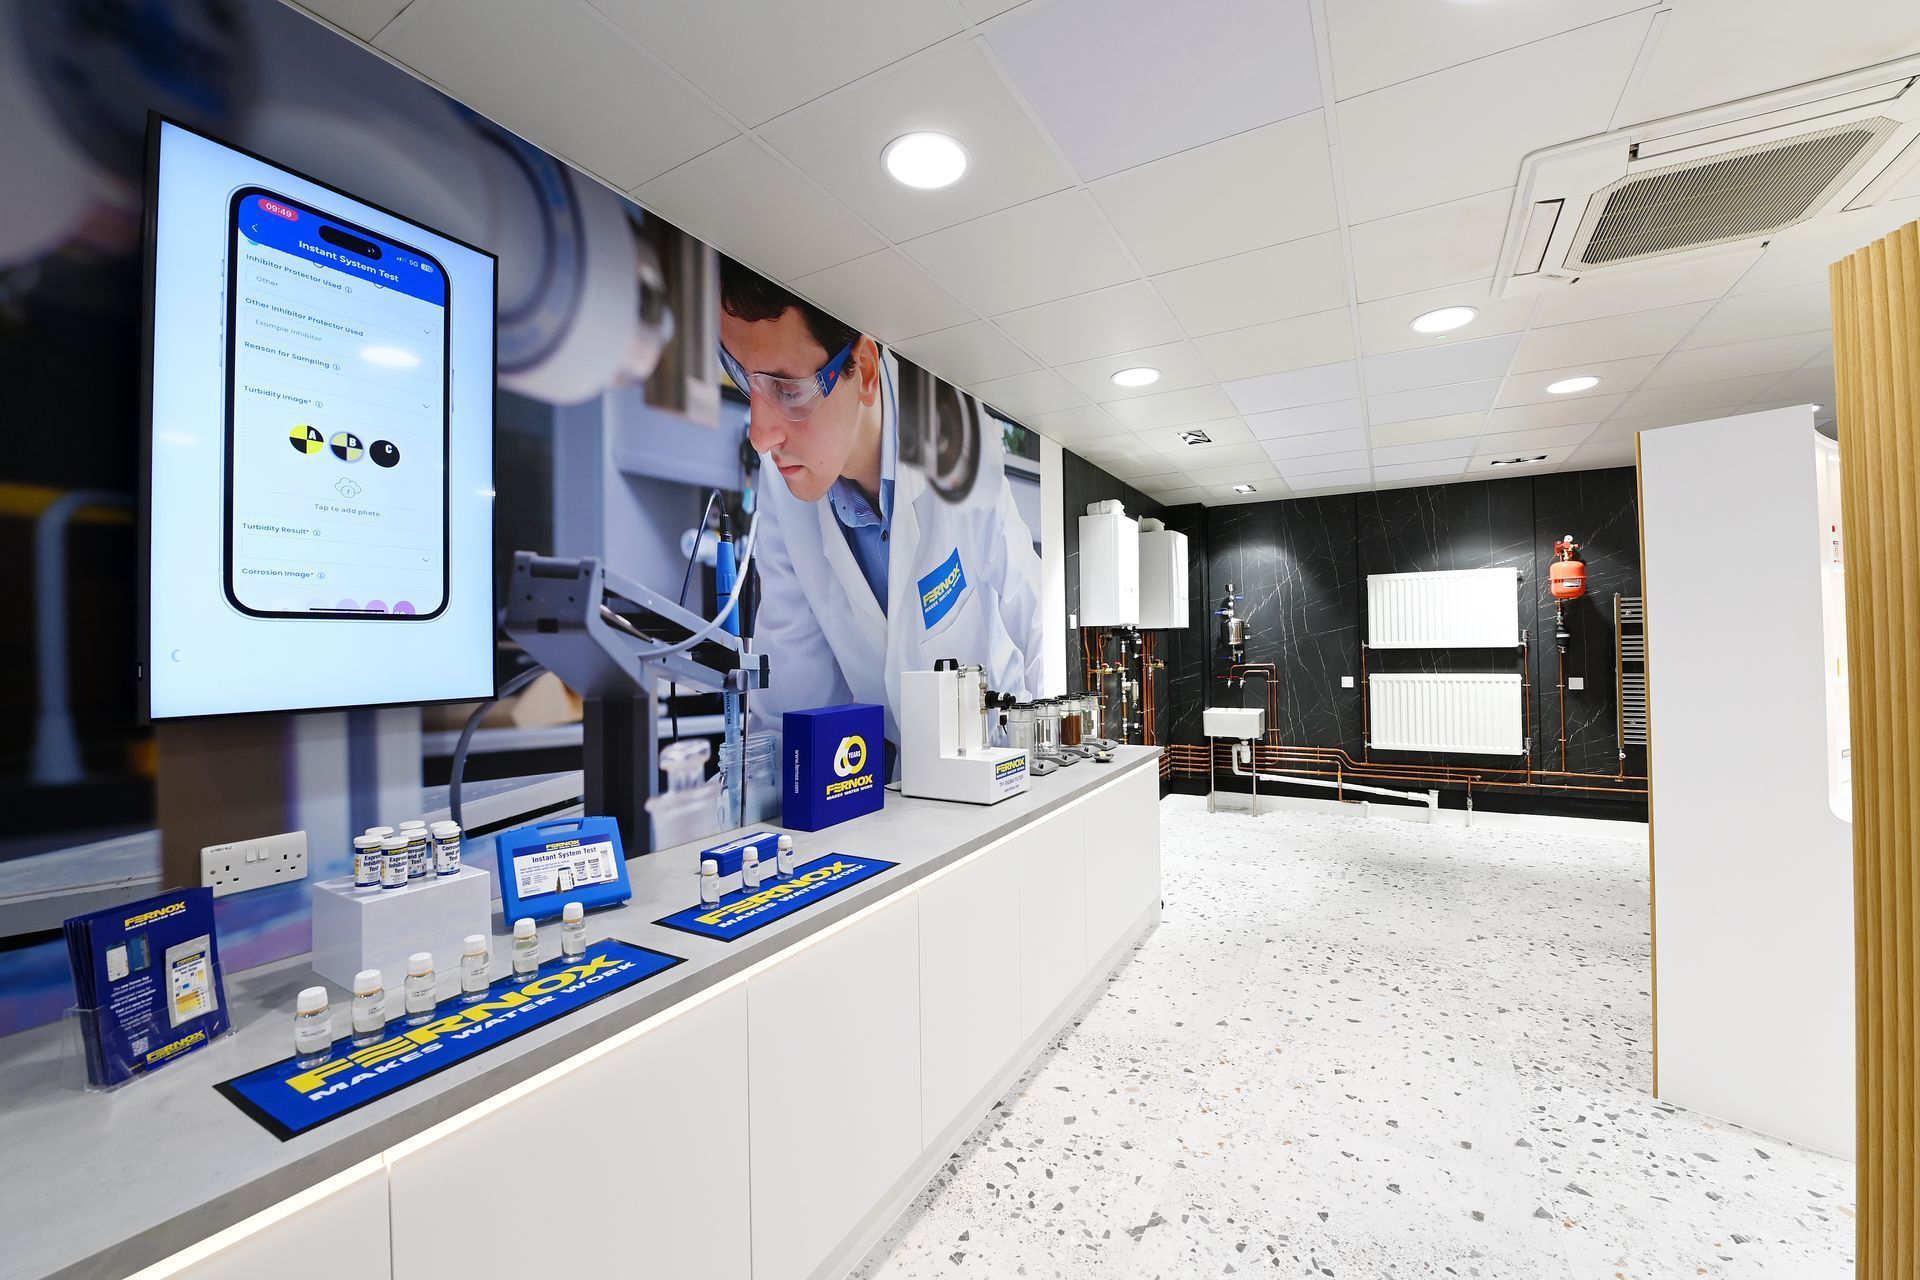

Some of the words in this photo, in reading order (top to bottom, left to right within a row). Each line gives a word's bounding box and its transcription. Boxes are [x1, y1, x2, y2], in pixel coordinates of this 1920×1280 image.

[266, 202, 292, 218] 09:49
[246, 254, 282, 271] Inhibitor
[284, 266, 321, 283] Protector
[323, 278, 342, 290] Used
[299, 240, 337, 260] Instant
[339, 255, 376, 275] System
[379, 268, 399, 282] Test
[256, 275, 279, 287] Other
[245, 297, 269, 309] Other
[271, 305, 306, 319] Inhibitor
[308, 316, 344, 332] Protector
[345, 327, 364, 337] Used
[255, 319, 289, 334] Example
[291, 328, 322, 342] Inhibitor
[244, 341, 276, 355] Reason
[278, 349, 290, 358] for
[292, 352, 330, 369] Sampling
[243, 385, 281, 399] Turbidity
[308, 429, 317, 440] A
[349, 438, 357, 447] B
[385, 445, 393, 454] C
[314, 504, 329, 513] Tap
[341, 507, 357, 515] add
[358, 509, 381, 518] photo
[242, 523, 280, 533] Turbidity
[242, 567, 283, 577] Corrosion
[922, 561, 961, 608] FERNOX
[833, 735, 867, 777] 60
[848, 750, 861, 759] YEARS
[996, 757, 1025, 774] FERNOX
[826, 774, 873, 795] FERNOX
[826, 792, 843, 801] MAKES
[844, 787, 860, 795] WATER
[532, 853, 557, 864] Instant
[558, 849, 582, 859] System
[583, 847, 597, 855] Test
[546, 839, 580, 850] FERNOX
[693, 861, 857, 925] FERNOX
[718, 902, 777, 928] MAKES
[778, 880, 828, 902] WATER
[828, 864, 867, 881] WORK
[124, 901, 186, 927] FERNOX
[285, 954, 625, 1094] FERNOX
[308, 1042, 444, 1101] MAKES
[451, 996, 557, 1039] WATER
[560, 961, 637, 993] WORK
[146, 1029, 206, 1063] FERNOX
